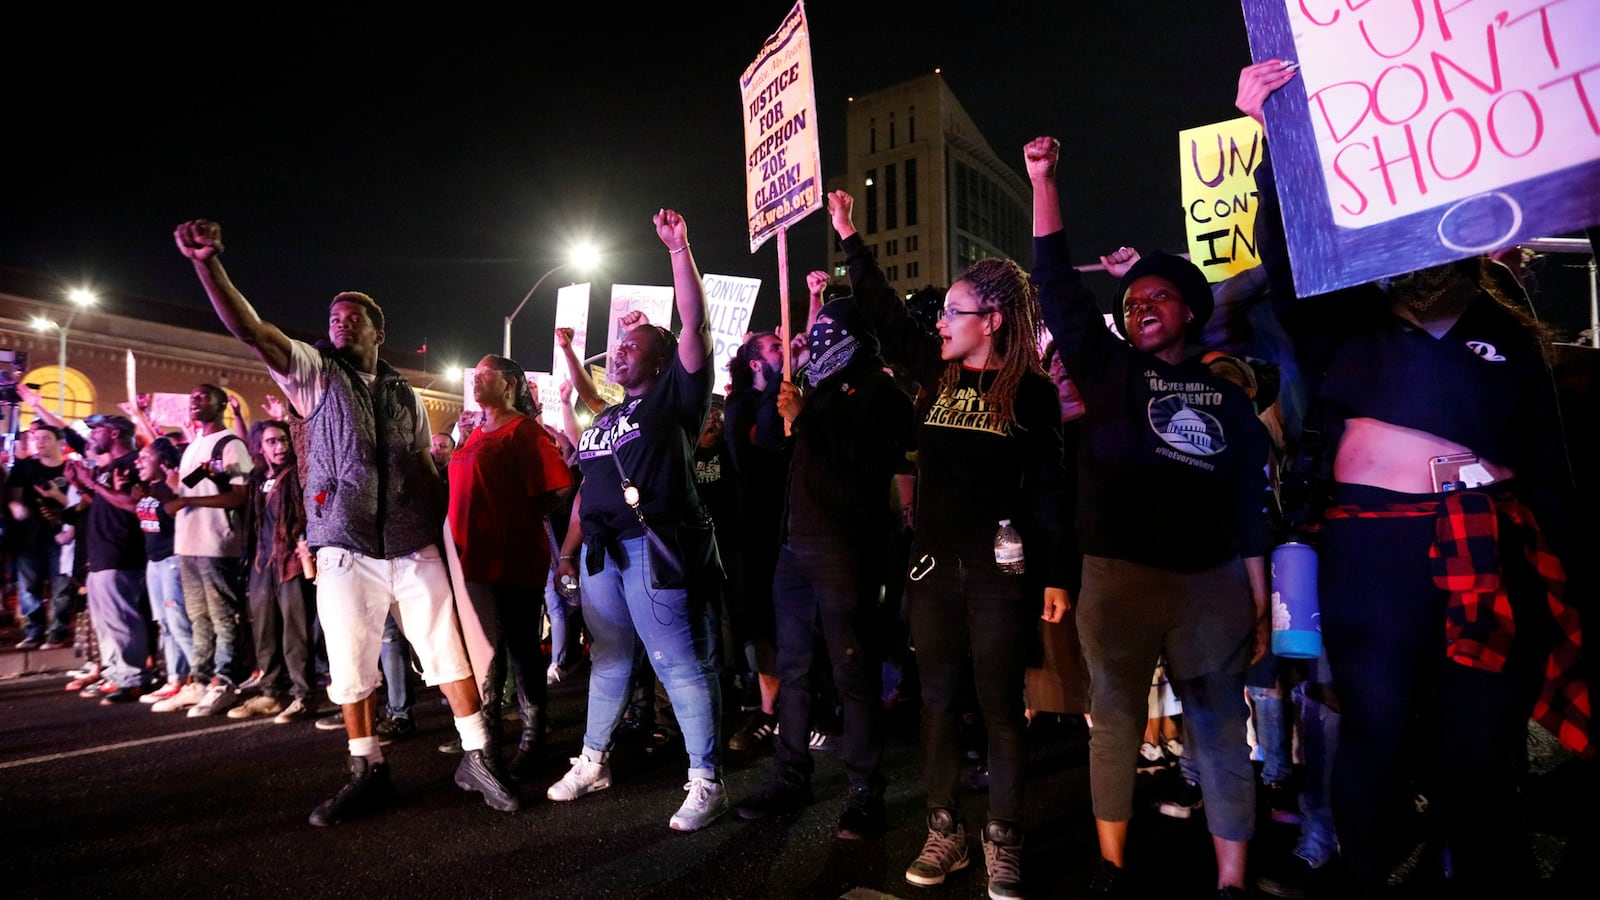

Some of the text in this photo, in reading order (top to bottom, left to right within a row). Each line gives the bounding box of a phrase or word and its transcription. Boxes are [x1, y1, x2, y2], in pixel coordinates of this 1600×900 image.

[749, 62, 799, 124] JUSTICE
[1308, 0, 1566, 143] DON'T
[748, 108, 807, 172] STEPHON
[759, 100, 784, 137] FOR
[1333, 63, 1600, 215] SHOOT
[754, 162, 801, 210] CLARK!
[704, 277, 758, 304] CONVICT
[709, 303, 748, 338] LLER
